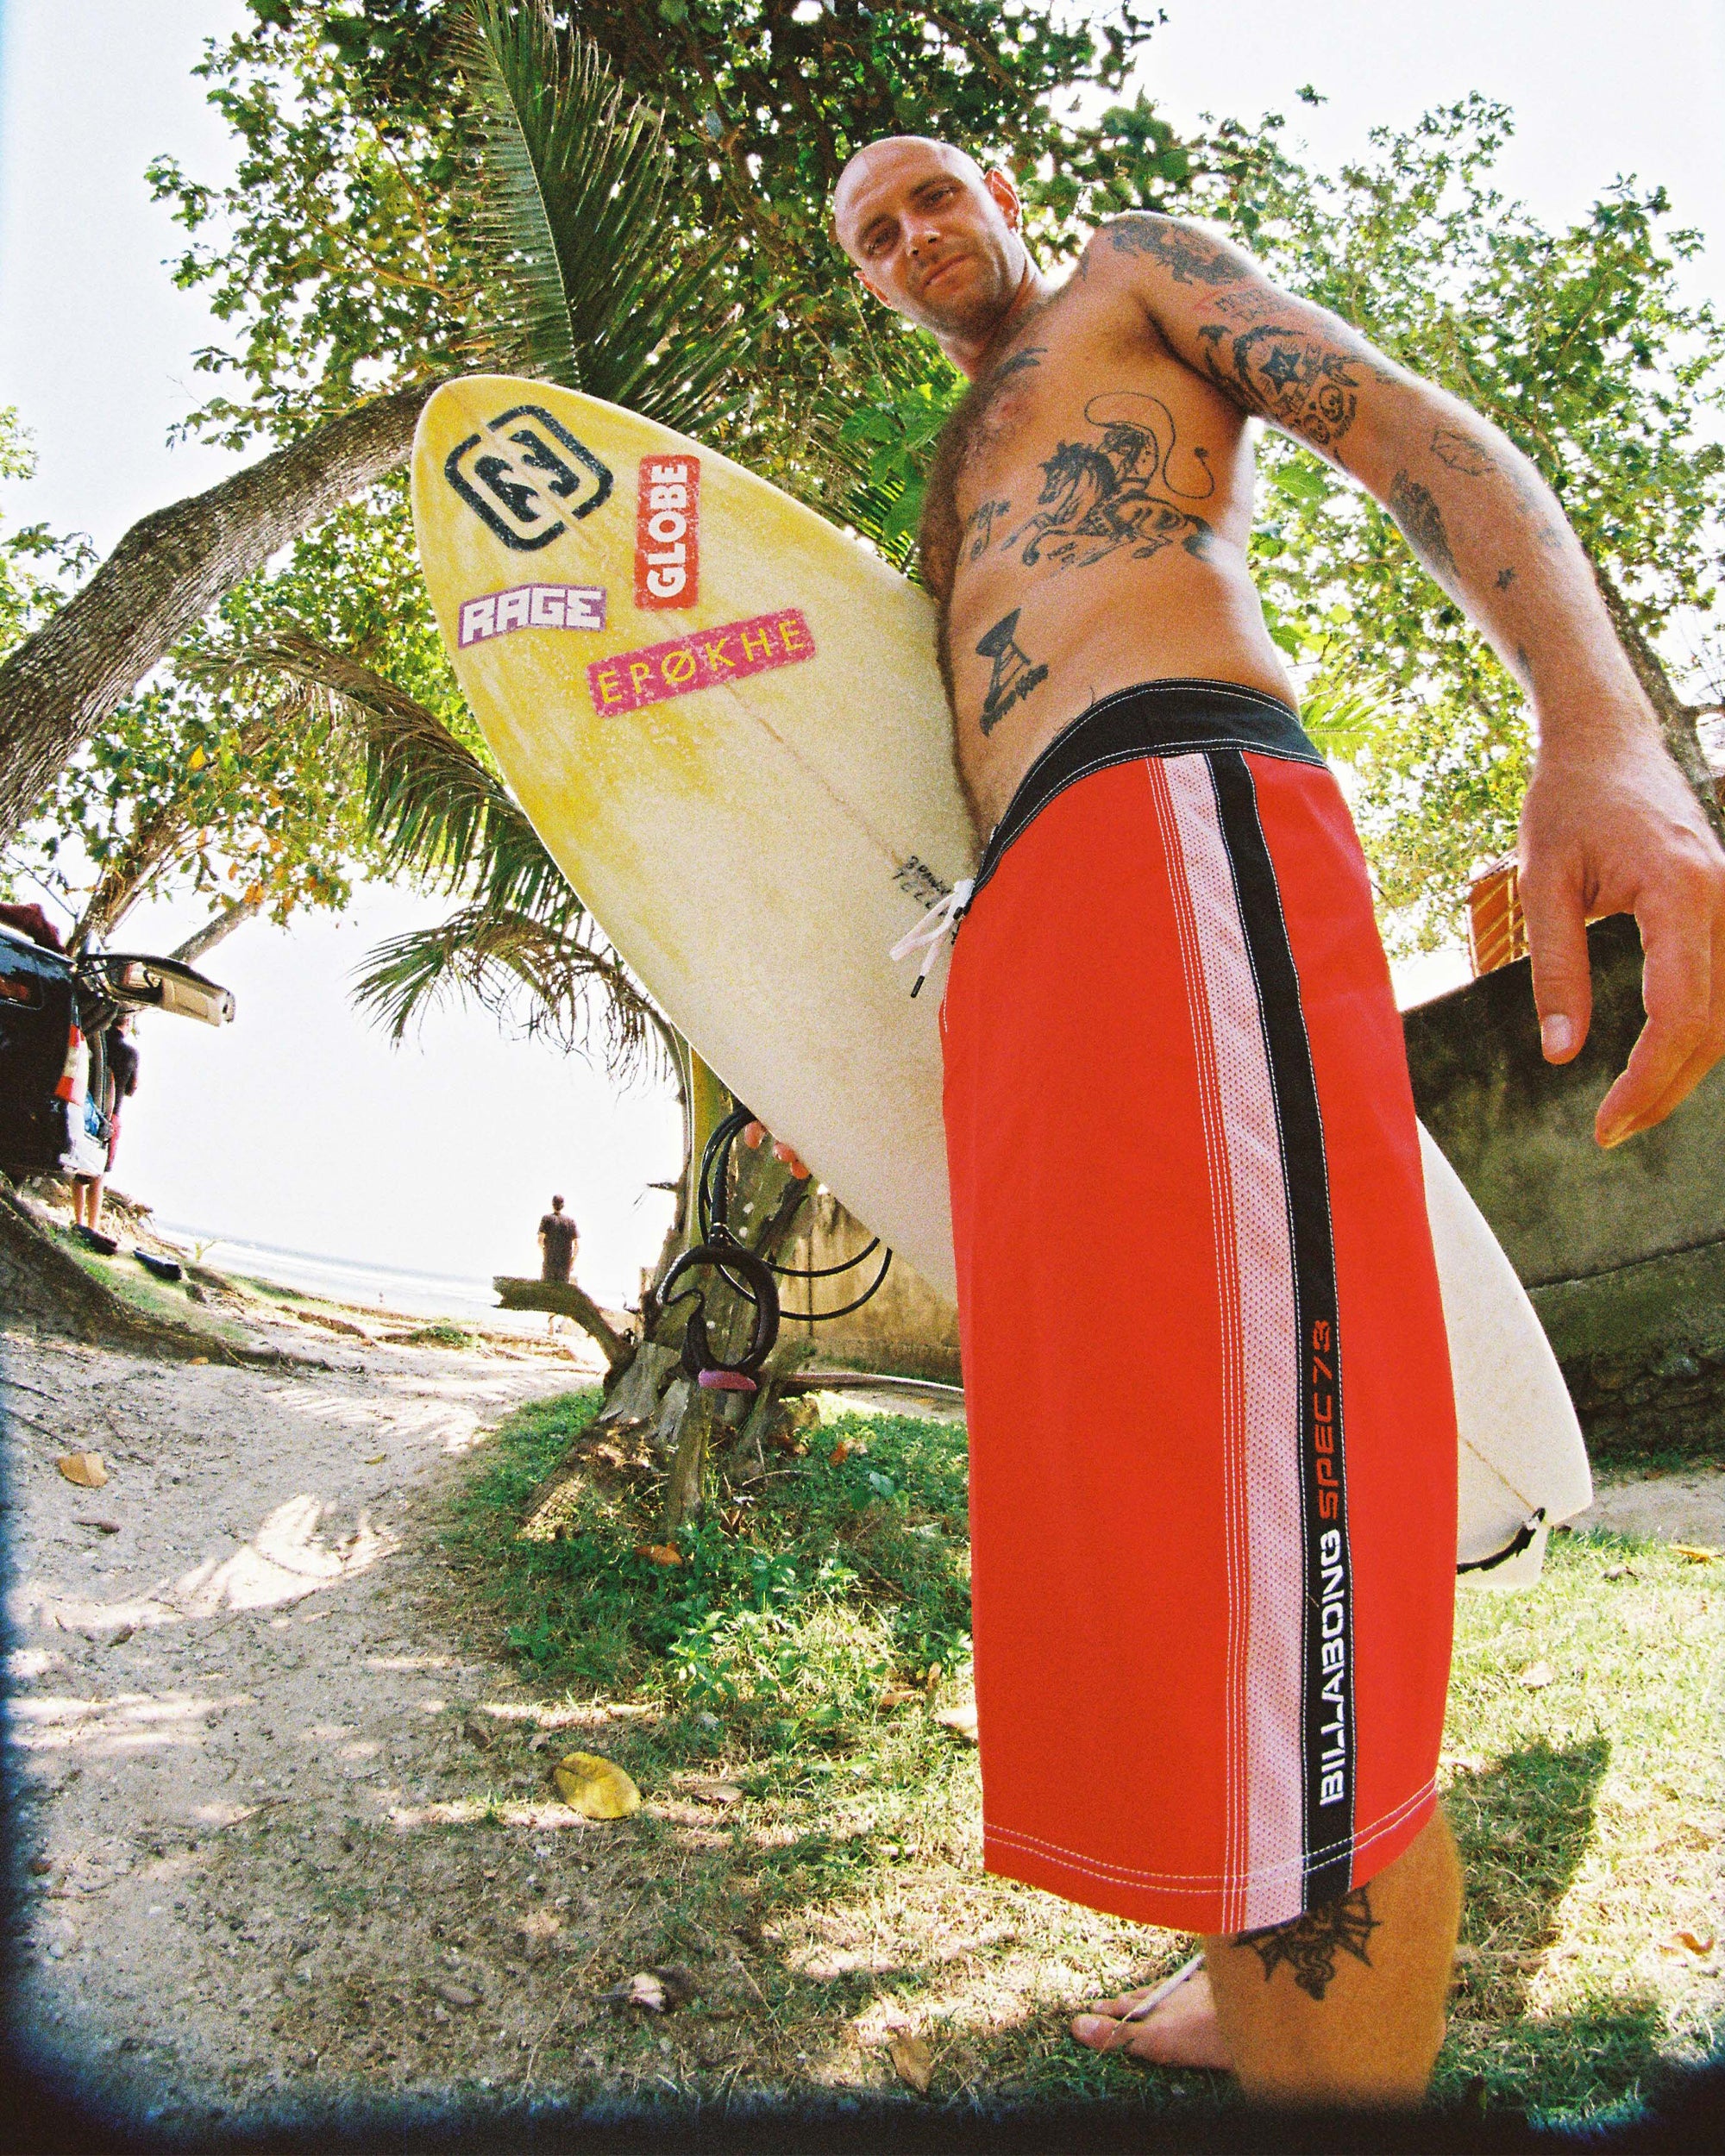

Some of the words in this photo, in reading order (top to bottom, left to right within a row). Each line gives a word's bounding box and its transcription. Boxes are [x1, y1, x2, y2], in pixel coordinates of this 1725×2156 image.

[647, 464, 688, 599] GLOBE
[461, 586, 603, 645] RAGE
[1320, 1528, 1346, 1806] BILLABONG
